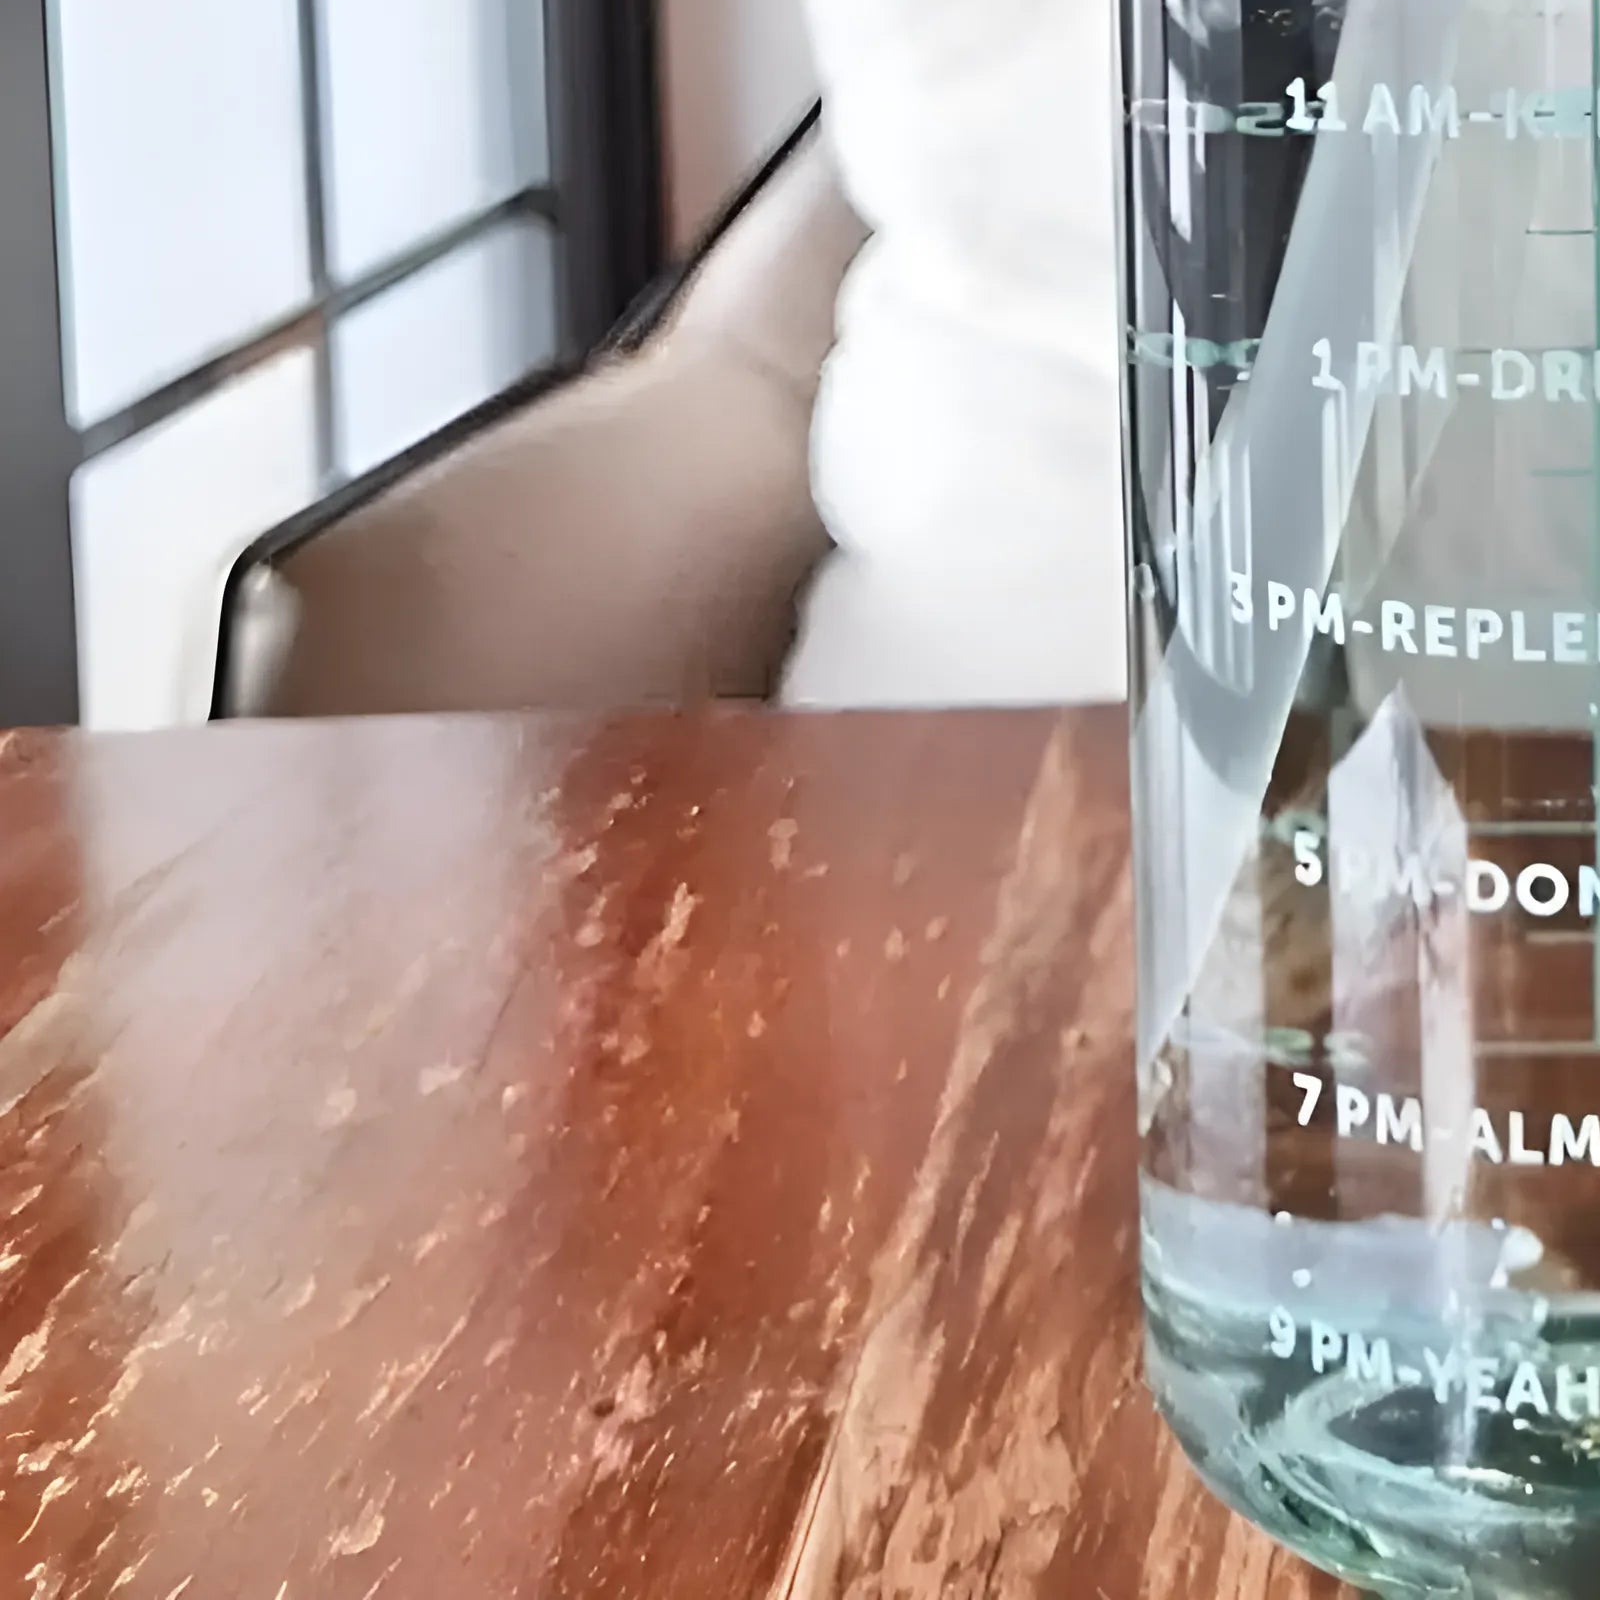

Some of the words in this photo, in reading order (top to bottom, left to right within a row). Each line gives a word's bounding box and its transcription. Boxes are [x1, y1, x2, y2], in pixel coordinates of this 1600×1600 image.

[1285, 77, 1348, 132] 11
[1311, 337, 1336, 387] 1
[1293, 830, 1323, 887] 5
[1292, 1071, 1323, 1127] 7
[1268, 1304, 1297, 1359] 9
